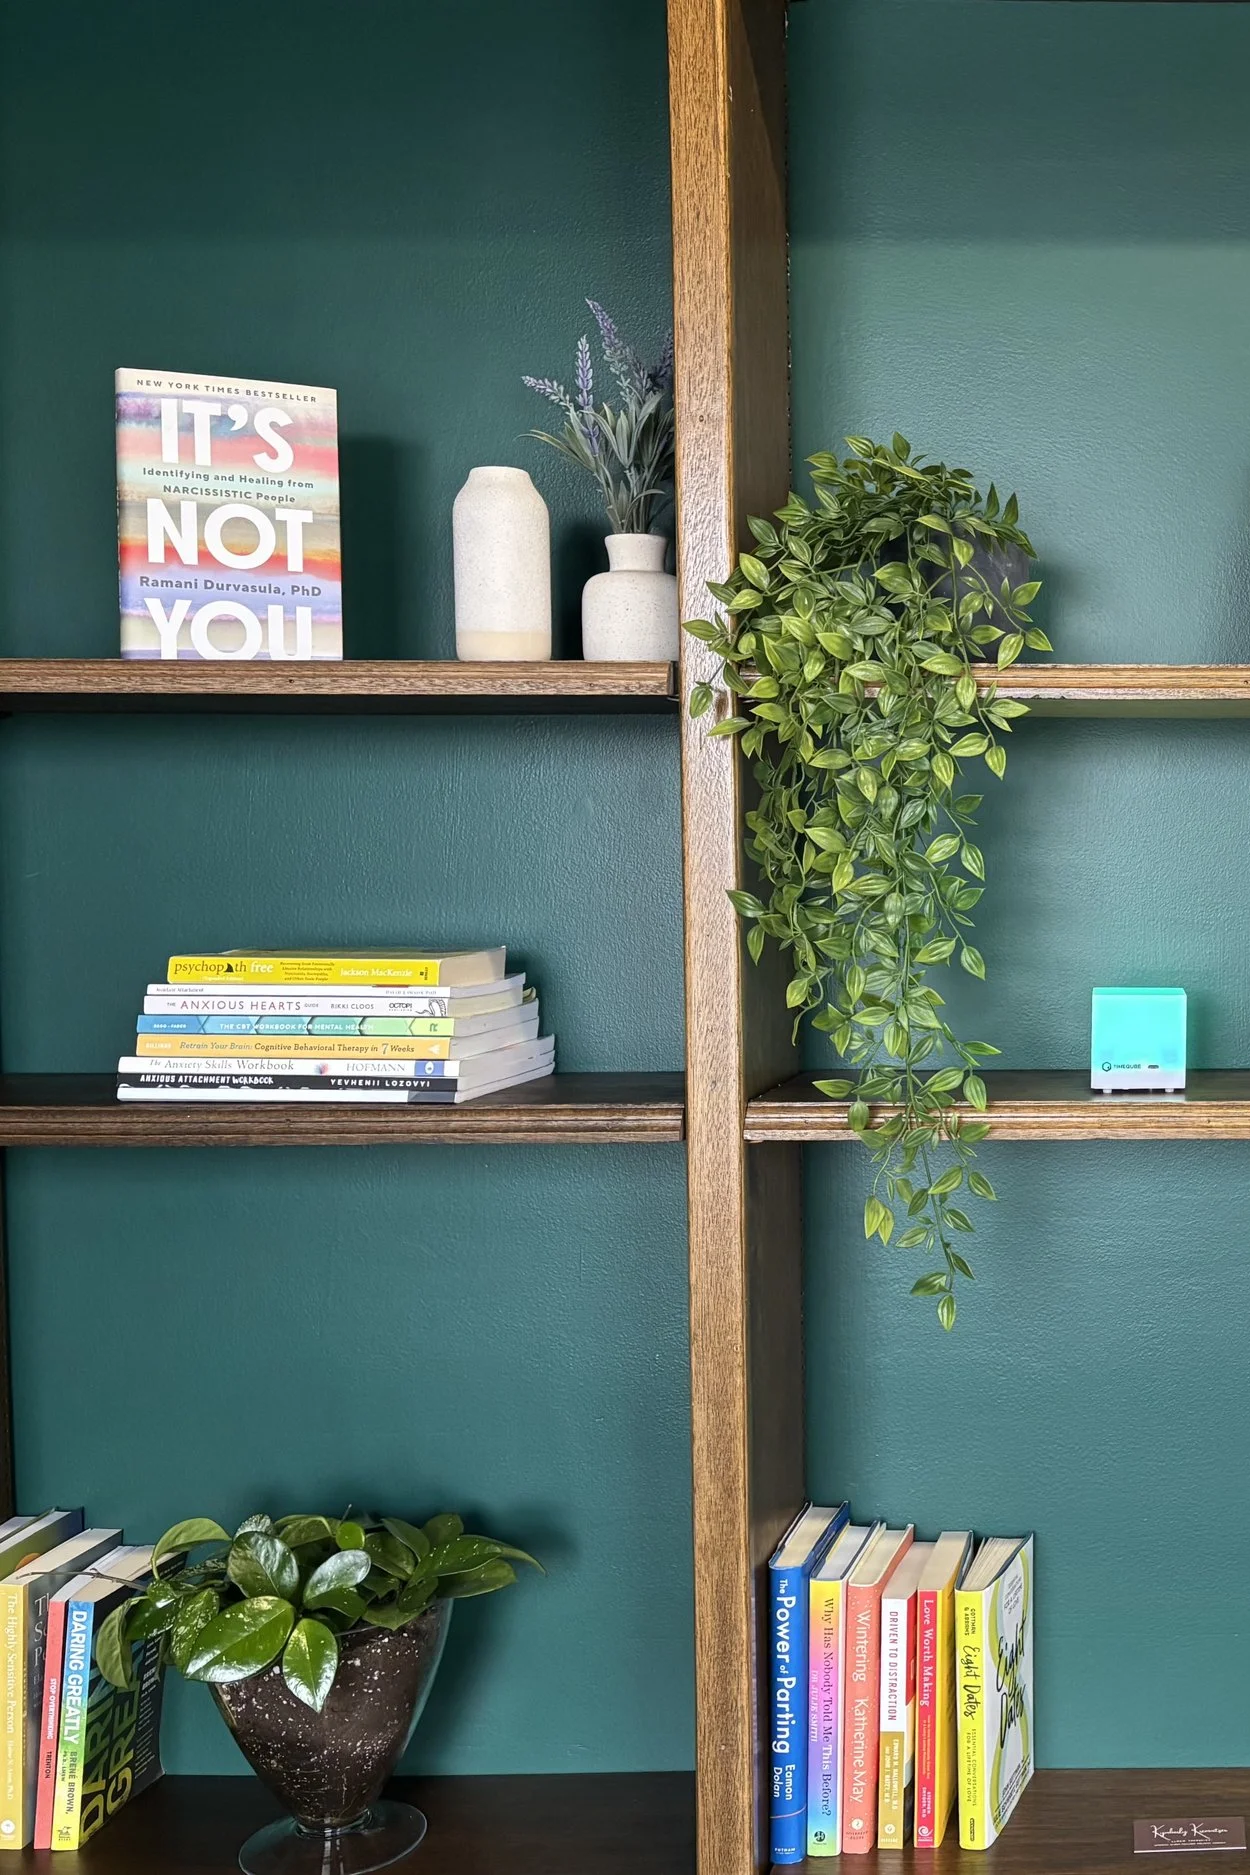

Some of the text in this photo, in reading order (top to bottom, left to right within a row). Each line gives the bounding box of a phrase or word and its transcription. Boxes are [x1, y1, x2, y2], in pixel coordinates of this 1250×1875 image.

[136, 379, 317, 403] NEW YORK TIMES BESTSELLER
[160, 397, 294, 474] IT'S
[143, 467, 315, 489] Identifying and Healing from
[163, 485, 296, 503] NARCISSISTIC People
[146, 498, 314, 573] NOT
[139, 575, 322, 598] Ramani Durvasula, PhD
[143, 597, 313, 660] YOU
[249, 960, 274, 973] free
[340, 967, 369, 977] Jackson
[180, 1000, 244, 1011] ANXIOUS
[250, 1001, 301, 1011] HEARTS
[253, 1023, 296, 1031] WORKBOOK
[315, 1023, 343, 1031] MENTAL
[205, 1059, 232, 1069] Skills
[236, 1059, 294, 1070] Workbook
[210, 1042, 228, 1050] Your
[254, 1043, 292, 1052] Cognitive
[294, 1043, 335, 1051] Behavioral
[337, 1043, 369, 1053] Therapy
[370, 1044, 378, 1052] in
[381, 1043, 389, 1055] 7
[390, 1044, 415, 1052] Weeks
[139, 1074, 176, 1083] ANXIOUS
[177, 1074, 231, 1084] ATTACHMENT
[923, 1599, 934, 1625] Love
[923, 1628, 934, 1662] Worth
[5, 1594, 18, 1734] The Highly Sensitive Person
[63, 1610, 88, 1745] DARING GREATLY
[771, 1579, 796, 1754] The Power of Parting
[888, 1611, 899, 1721] DRIVEN TO DISTRACTION
[919, 1666, 934, 1707] Making
[960, 1645, 982, 1721] Eight Dates
[820, 1598, 834, 1816] Why Has Nobody Told Me This Before?
[849, 1609, 871, 1804] Wintering Katherine May
[773, 1766, 783, 1799] Dolan
[785, 1763, 796, 1800] Eamon
